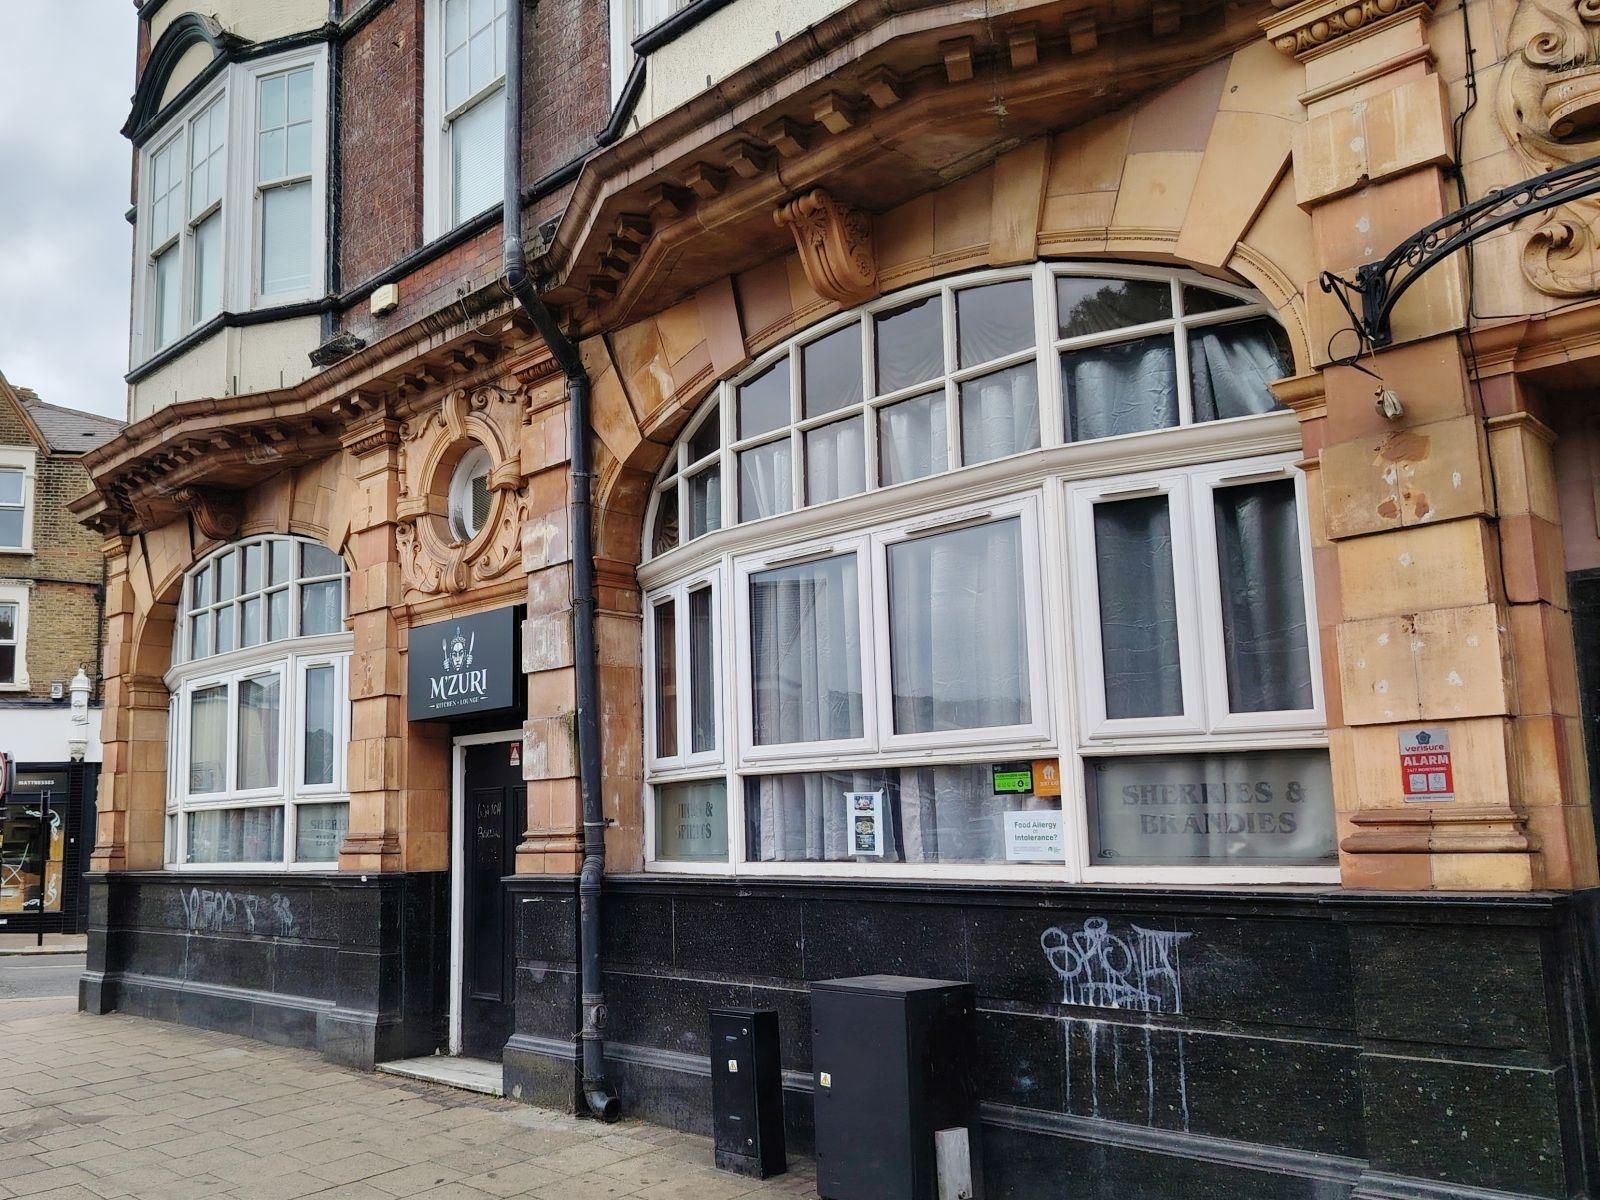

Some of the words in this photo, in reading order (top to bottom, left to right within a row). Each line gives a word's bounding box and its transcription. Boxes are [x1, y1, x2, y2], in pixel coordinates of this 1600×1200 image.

[429, 669, 487, 700] M'ZURI
[435, 699, 457, 709] KITCHEN
[459, 696, 479, 706] LOUNGE
[1405, 744, 1445, 752] verisure
[1404, 754, 1449, 767] ALARM
[1122, 781, 1273, 806] SHERRIES
[1285, 781, 1306, 804] &
[1014, 821, 1031, 829] Food
[1032, 821, 1057, 829] Allergy
[1139, 811, 1298, 835] BRANDIES
[1014, 833, 1058, 841] Intolerance?
